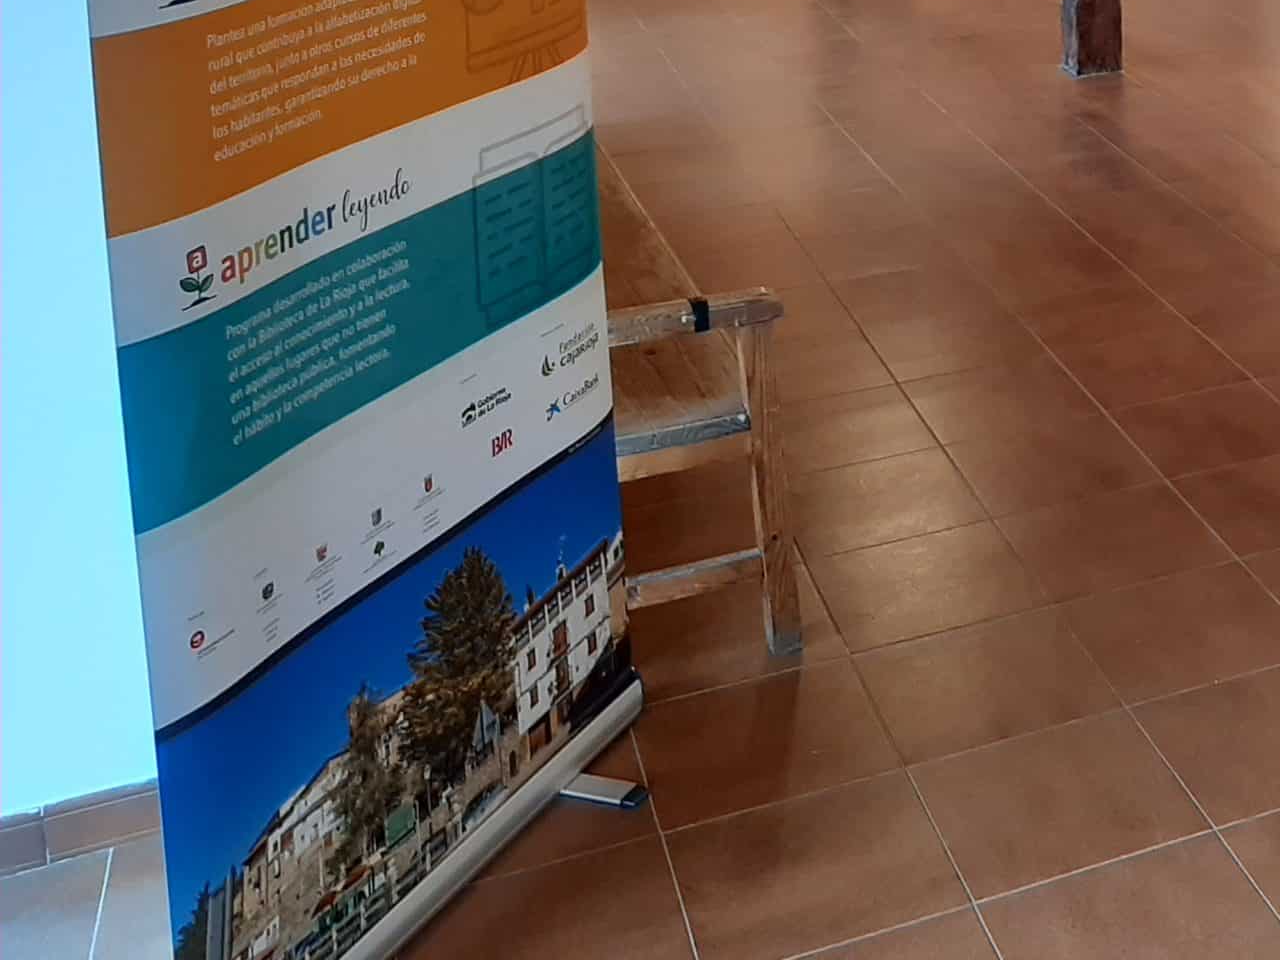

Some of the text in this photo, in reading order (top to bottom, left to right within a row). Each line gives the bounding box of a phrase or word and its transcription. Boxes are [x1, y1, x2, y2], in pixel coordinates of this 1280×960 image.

[207, 30, 246, 48] Plantea
[248, 21, 266, 36] una
[208, 53, 234, 71] rural
[235, 47, 255, 64] que
[256, 30, 305, 55] contribuya
[314, 20, 324, 33] la
[209, 78, 227, 95] del
[275, 52, 301, 74] junto
[309, 40, 334, 58] otros
[335, 32, 366, 51] cursos
[367, 24, 380, 39] de
[381, 11, 427, 34] diferentes
[261, 83, 280, 100] que
[280, 64, 330, 90] respondan
[340, 55, 353, 69] las
[354, 38, 413, 64] necesidades
[414, 31, 426, 46] de
[212, 124, 229, 140] los
[348, 76, 360, 90] su
[361, 60, 400, 82] derecho
[408, 53, 417, 67] la
[221, 167, 410, 285] aprender leyendo
[226, 307, 272, 341] Programa
[332, 268, 345, 283] en
[228, 342, 247, 361] con
[247, 334, 257, 350] la
[305, 300, 318, 316] de
[358, 274, 377, 294] que
[228, 366, 239, 383] el
[273, 343, 284, 358] al
[364, 293, 374, 308] la
[230, 388, 245, 404] en
[321, 329, 341, 352] que
[341, 322, 355, 338] no
[231, 407, 252, 426] una
[233, 428, 244, 446] el
[282, 399, 293, 415] la
